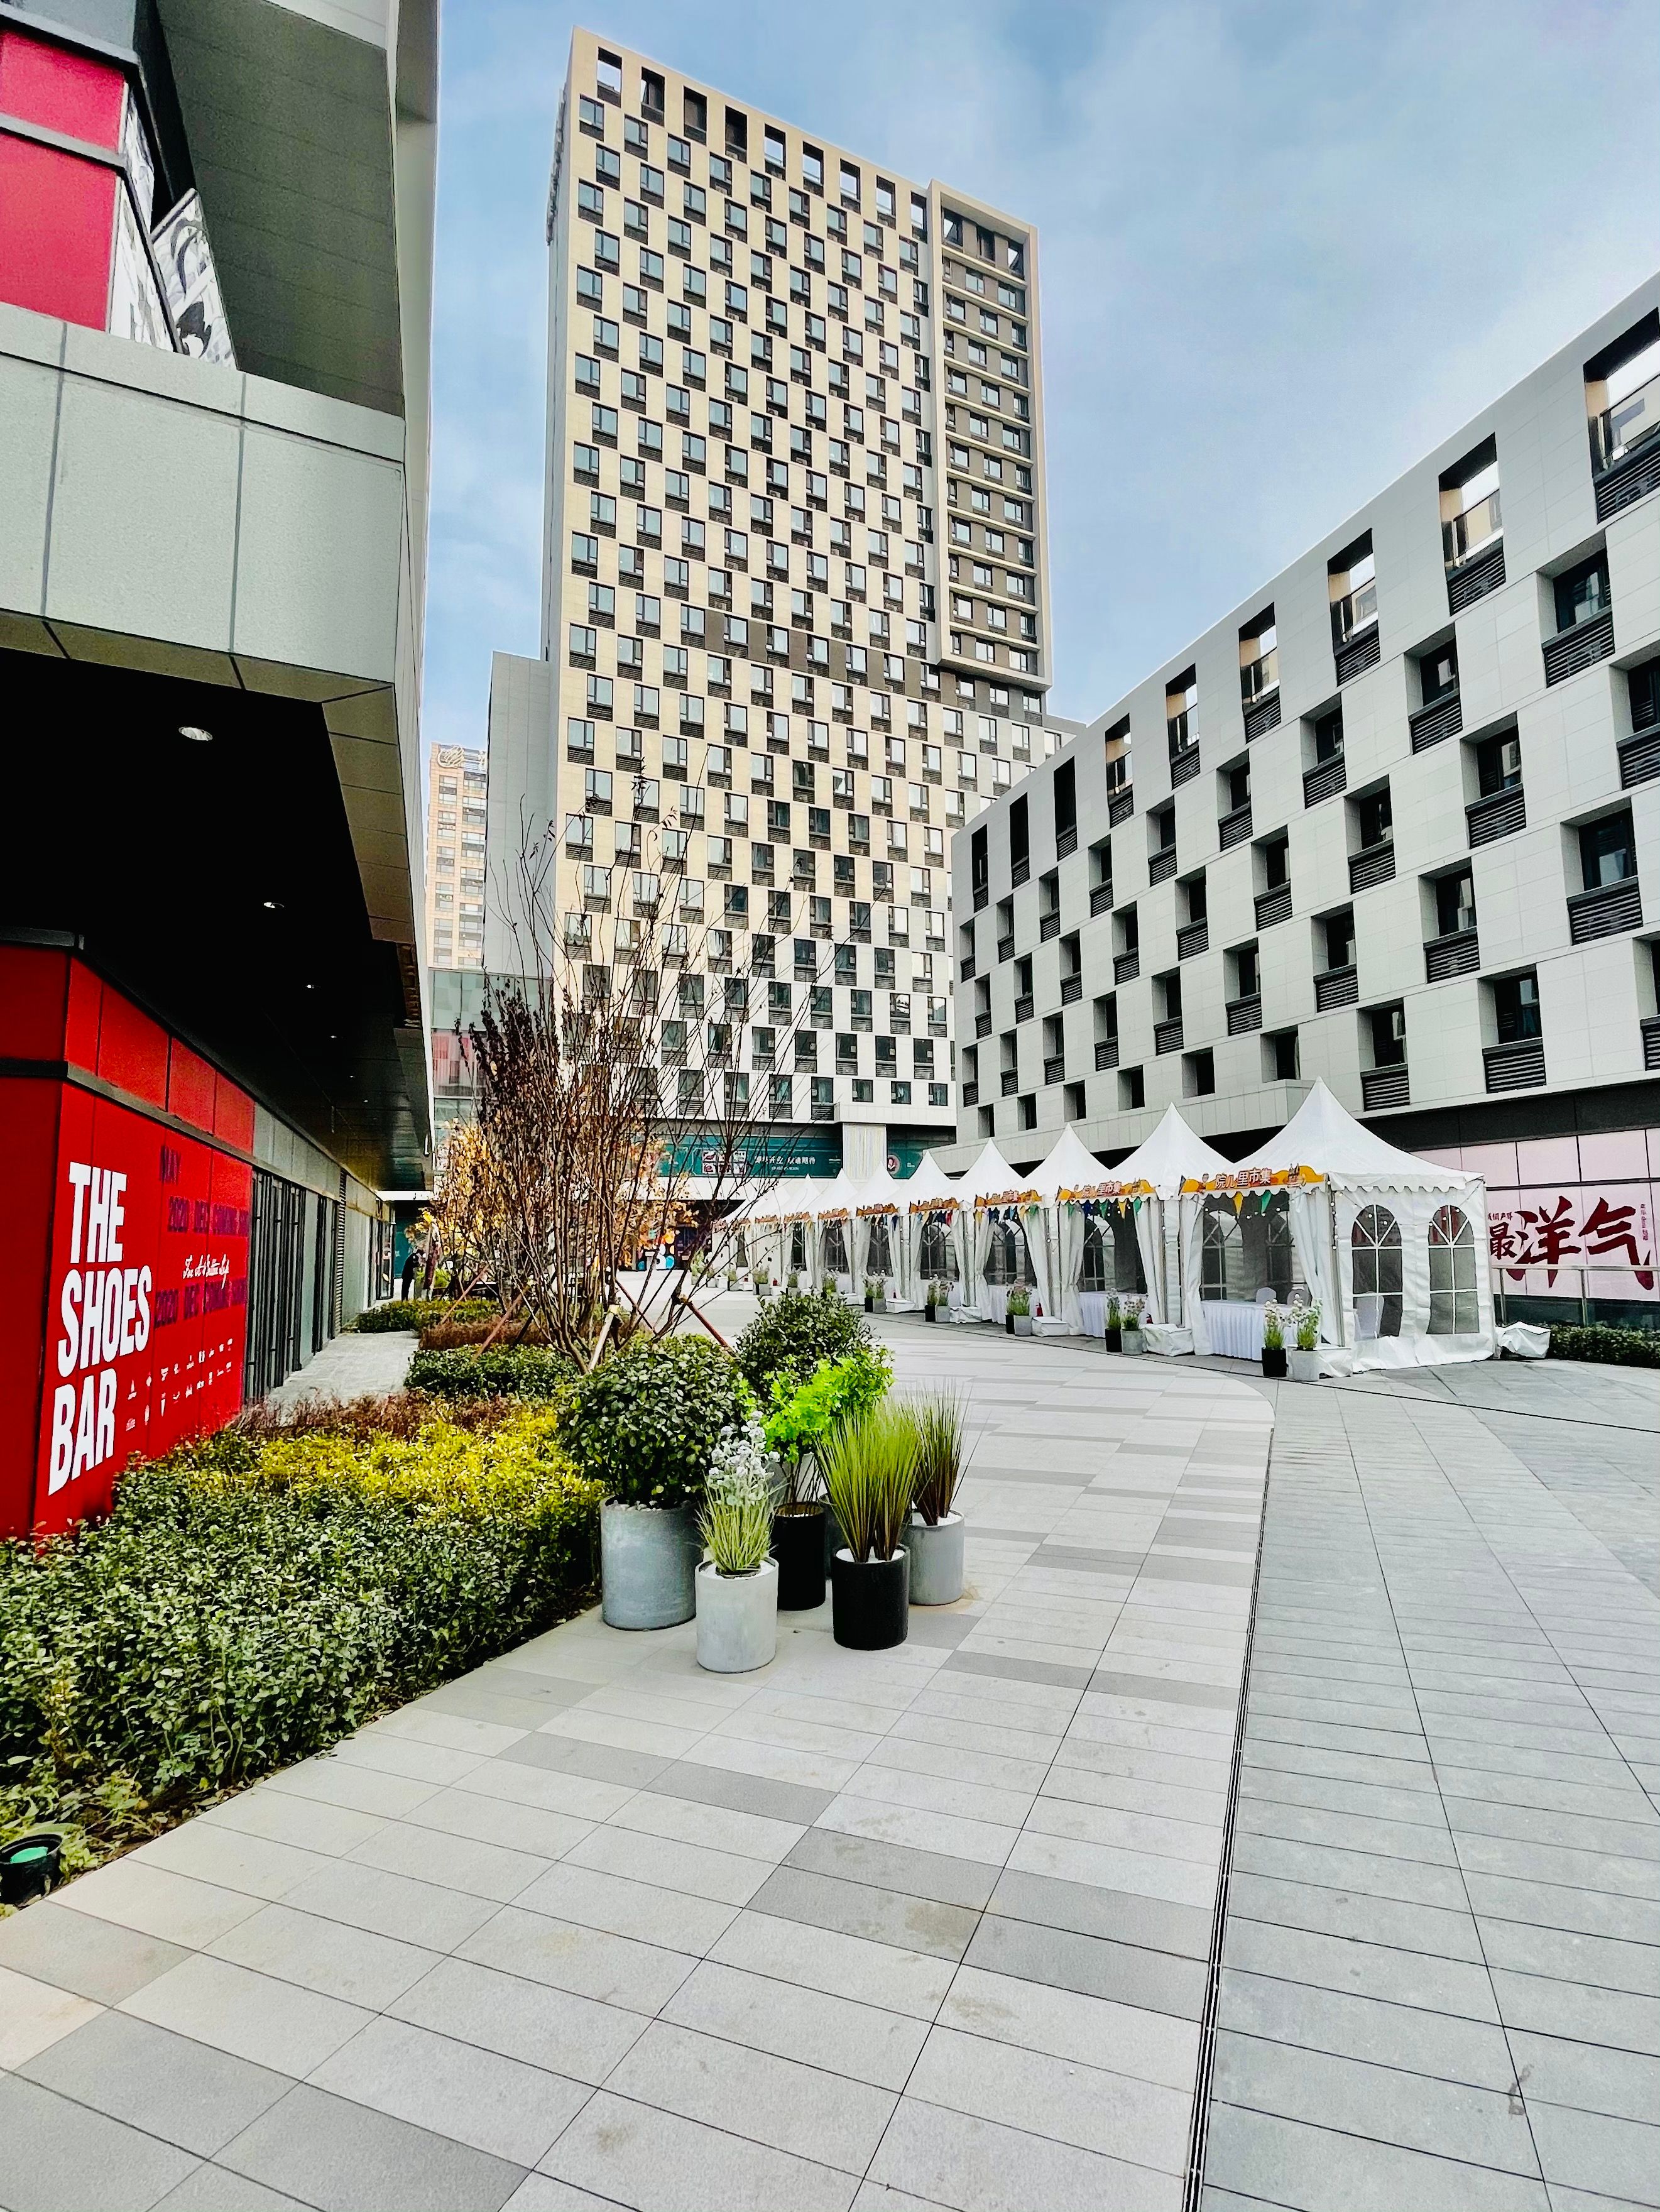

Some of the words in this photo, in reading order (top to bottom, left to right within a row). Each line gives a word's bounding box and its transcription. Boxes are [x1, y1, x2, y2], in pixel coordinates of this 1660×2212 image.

[68, 1161, 127, 1264] THE
[1215, 1168, 1272, 1189] 院儿里市集
[1490, 1196, 1654, 1290] 最洋气
[58, 1265, 151, 1377] SHOES
[48, 1368, 117, 1496] BAR
